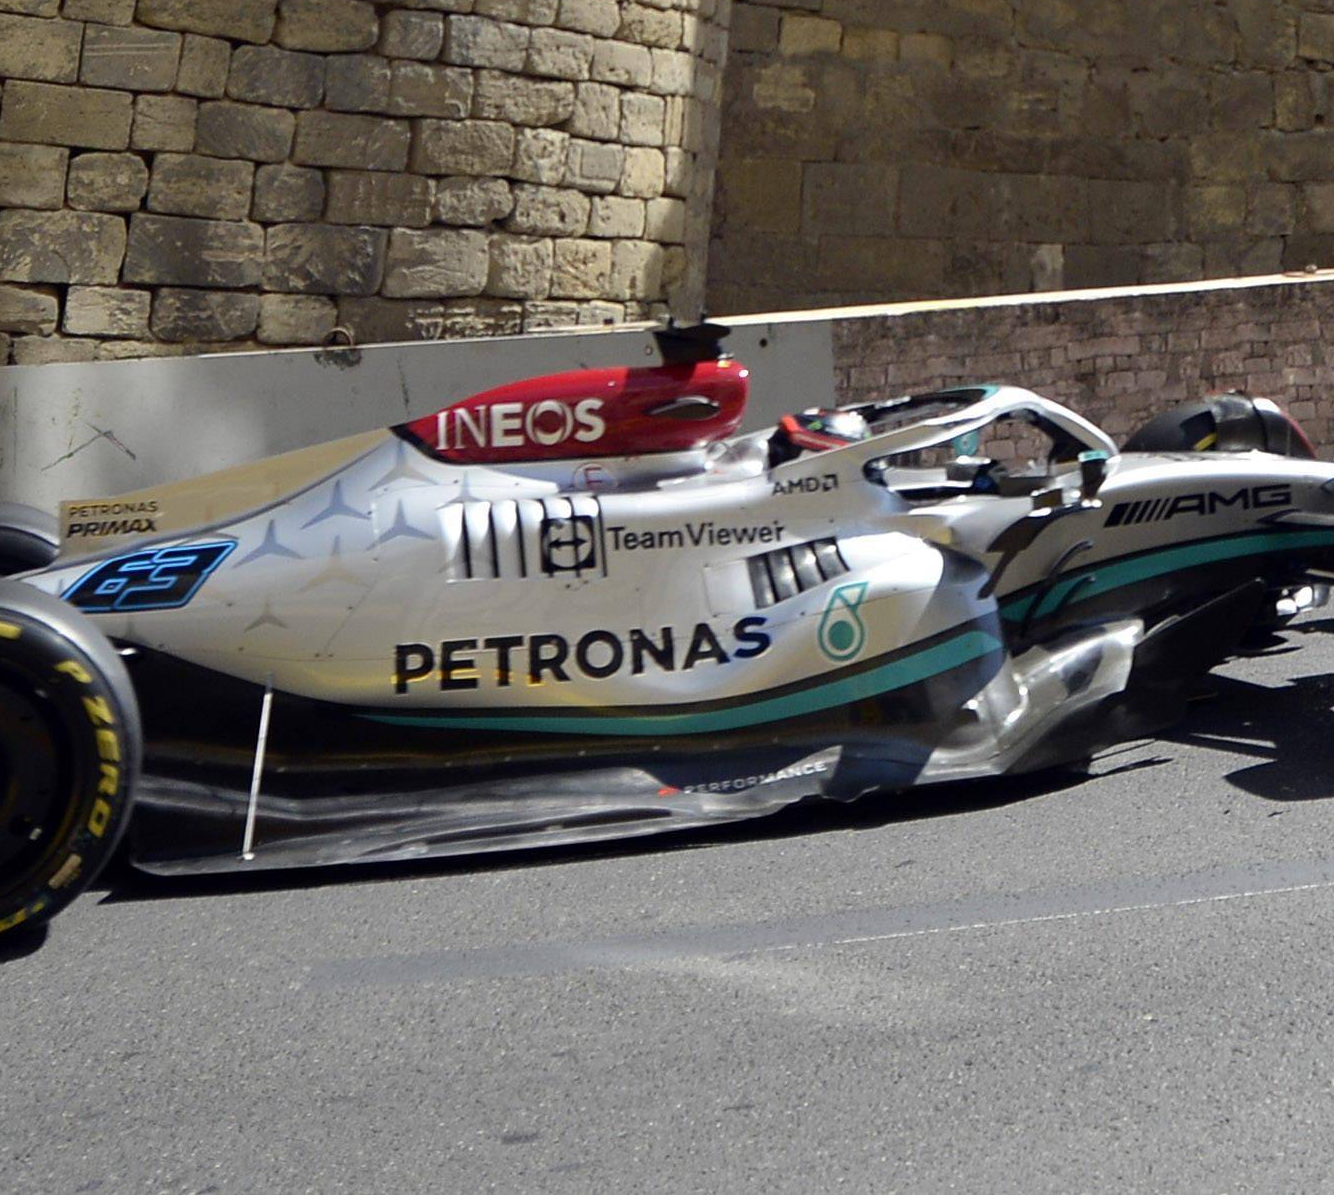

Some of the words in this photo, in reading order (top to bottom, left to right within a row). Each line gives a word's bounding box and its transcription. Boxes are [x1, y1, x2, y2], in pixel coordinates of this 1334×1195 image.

[435, 397, 606, 451] INEOS
[772, 477, 821, 496] AMD
[1164, 483, 1292, 521] AMG
[69, 501, 159, 518] PETRONAS
[66, 518, 157, 538] PRIMAX
[606, 522, 785, 551] TeamViewer
[61, 540, 238, 614] 63
[394, 616, 773, 695] PETRONAS
[82, 695, 121, 838] ZERO
[683, 761, 828, 794] PERFORMANCE
